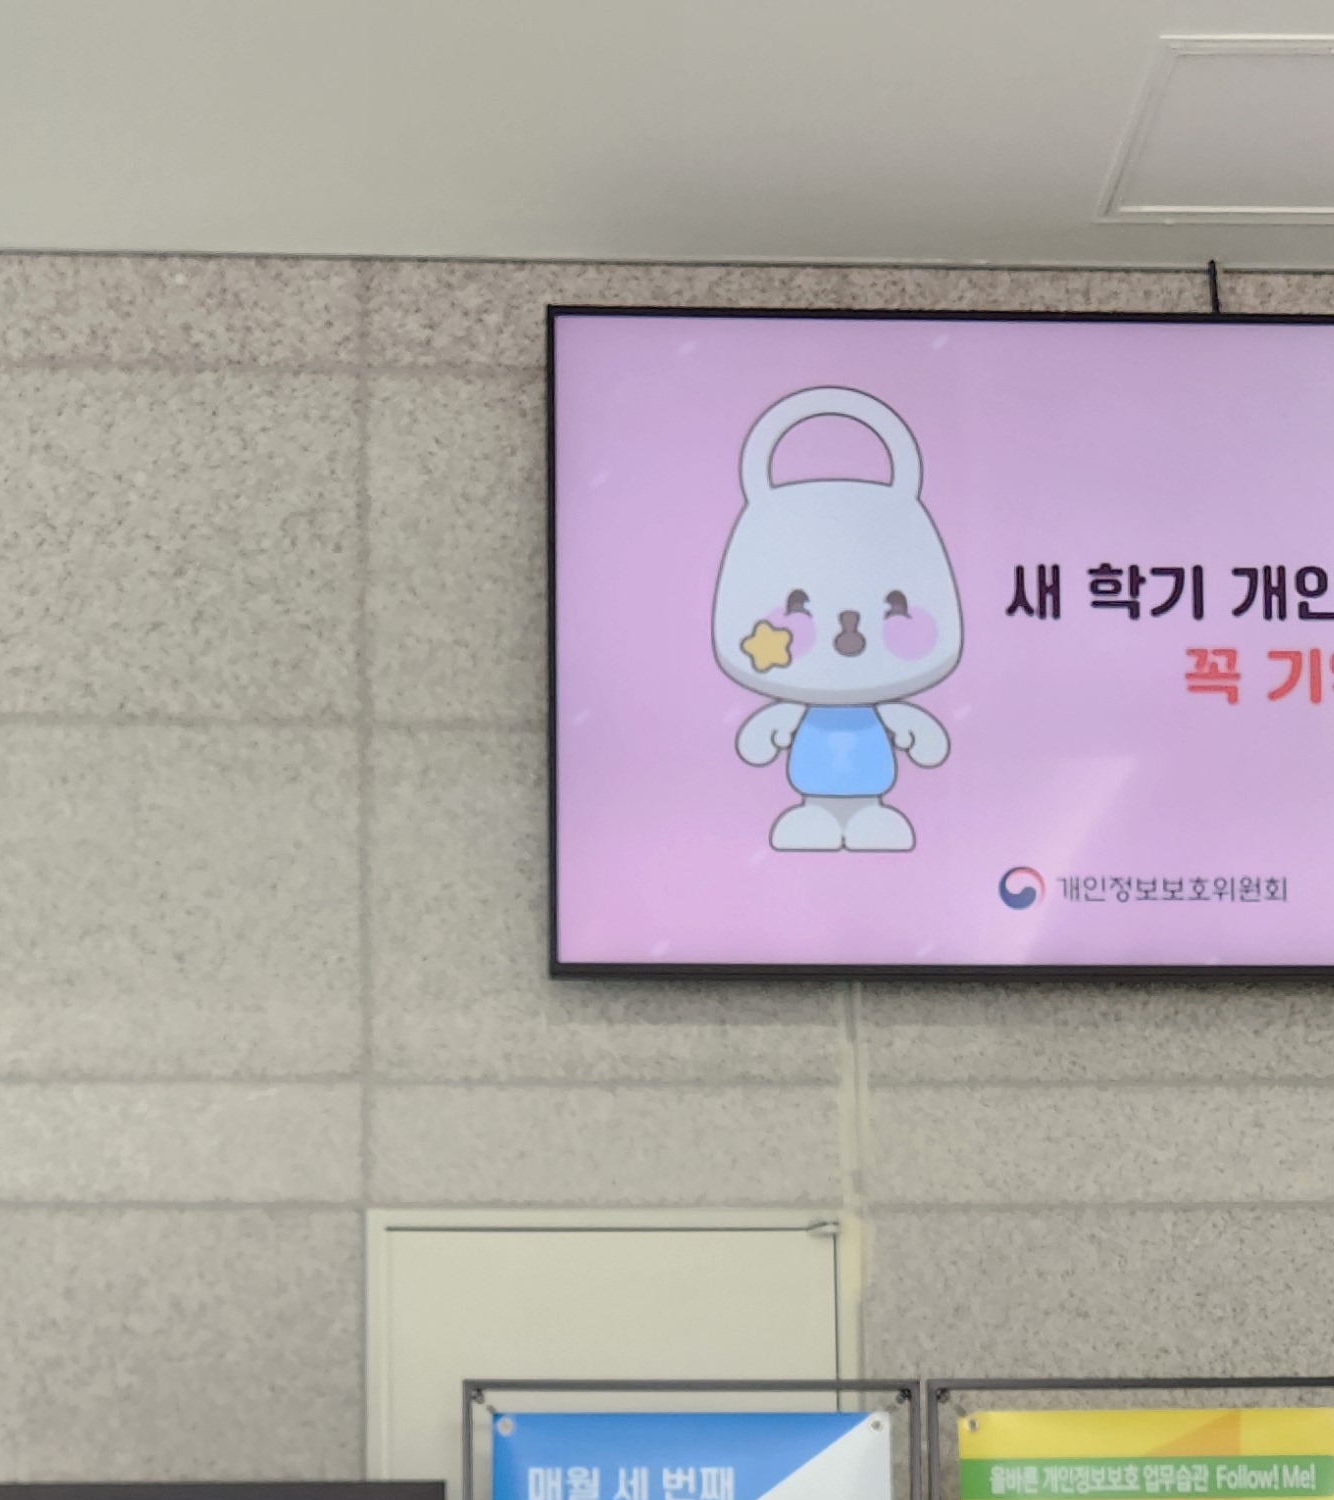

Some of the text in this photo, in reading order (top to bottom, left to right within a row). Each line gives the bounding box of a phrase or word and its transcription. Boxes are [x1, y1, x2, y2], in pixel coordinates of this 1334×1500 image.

[1005, 564, 1063, 621] 새
[1086, 562, 1207, 620] 학기
[1184, 647, 1242, 704] 꼭
[1057, 875, 1287, 903] 개인정보보호위원회
[989, 1463, 1316, 1494] 올바른 개인정보보호 업무습관 Follow! Me!
